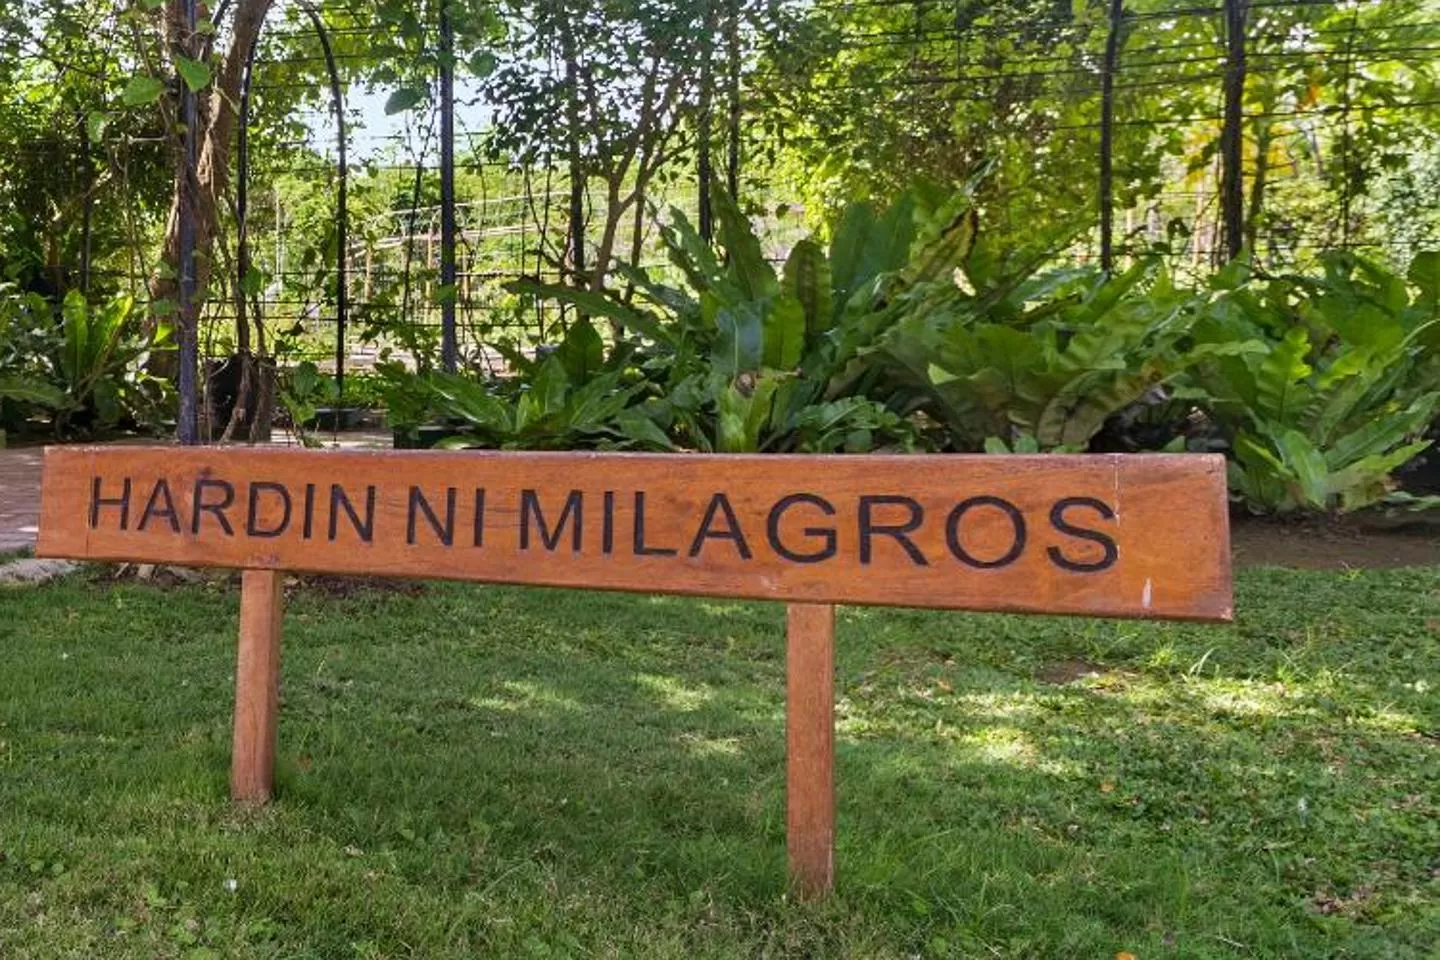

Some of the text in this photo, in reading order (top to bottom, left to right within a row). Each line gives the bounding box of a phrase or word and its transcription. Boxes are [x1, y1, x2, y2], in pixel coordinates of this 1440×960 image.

[90, 475, 1120, 574] HARDIN NI MILAGROS
